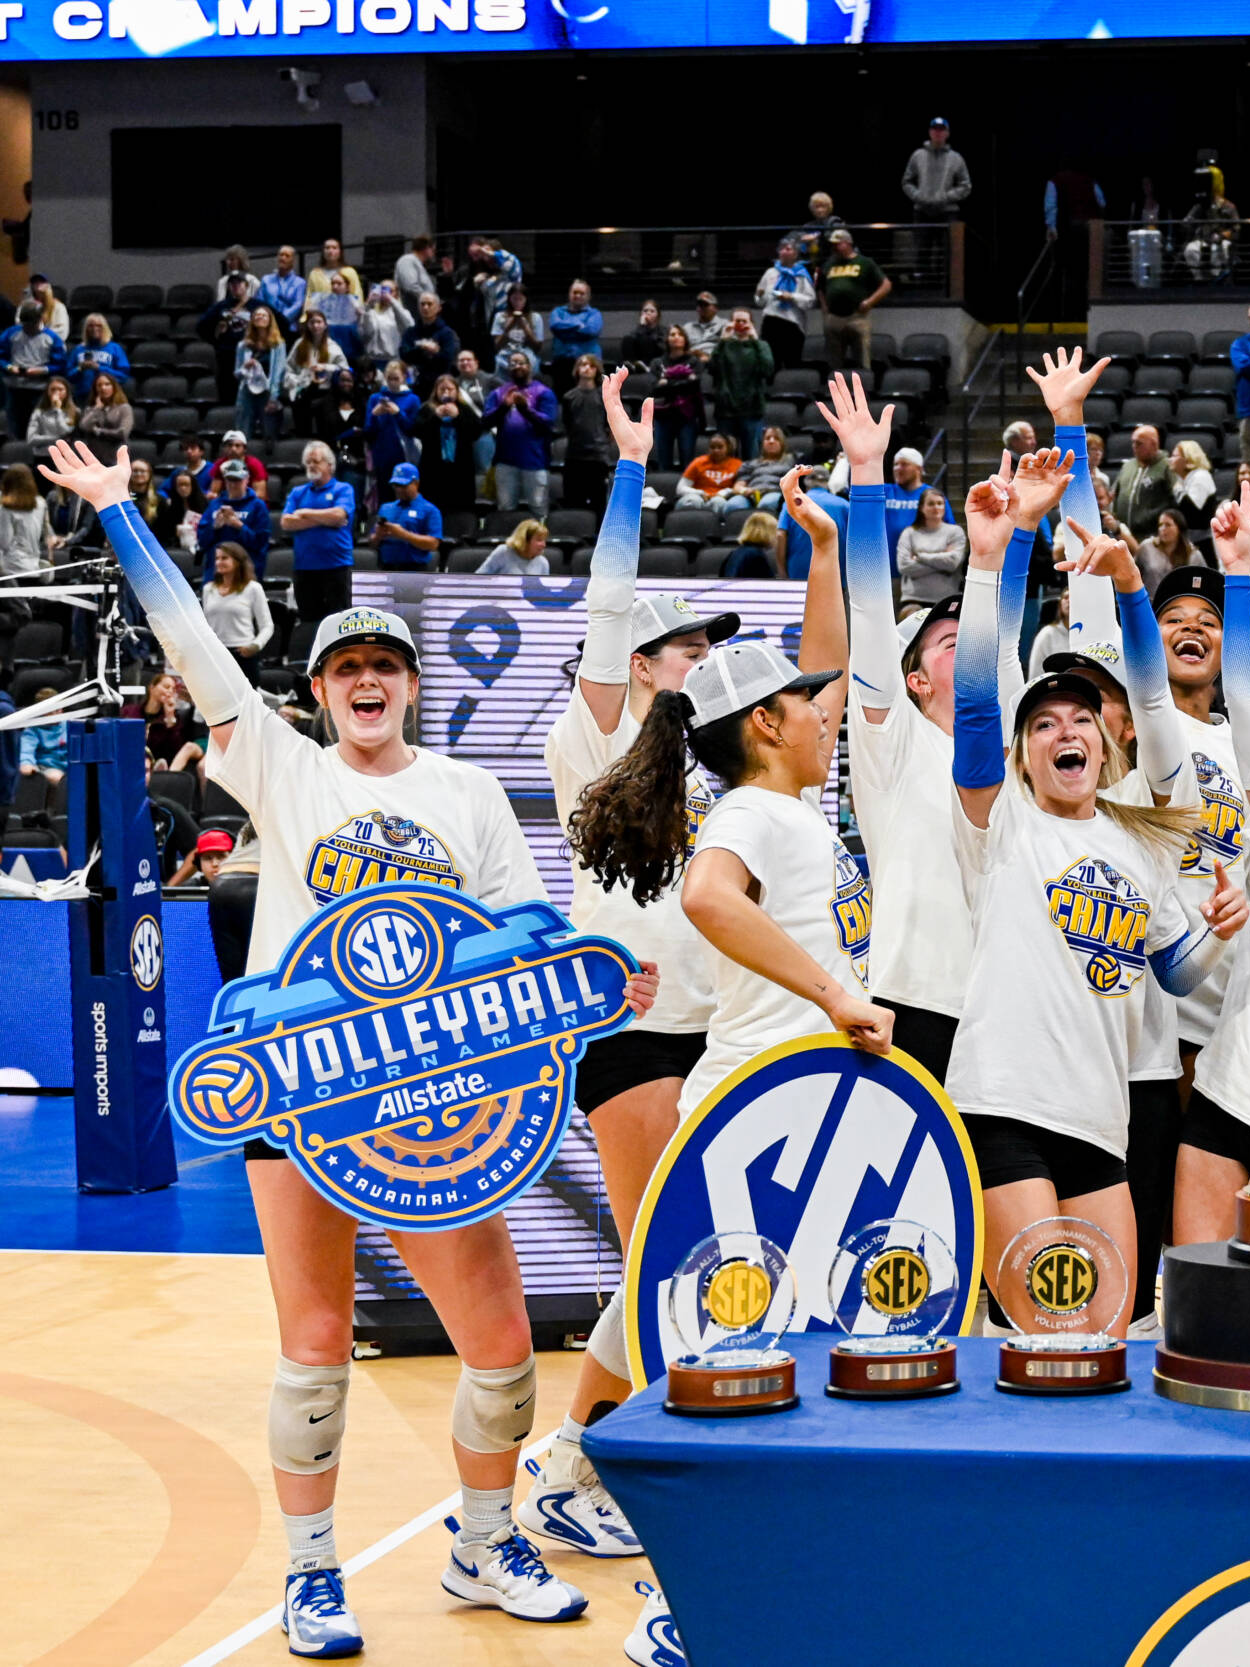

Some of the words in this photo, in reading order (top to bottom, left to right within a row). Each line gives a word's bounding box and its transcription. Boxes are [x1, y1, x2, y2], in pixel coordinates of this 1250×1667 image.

[35, 110, 79, 130] 106
[340, 620, 389, 634] CHAMPS
[1220, 777, 1233, 793] 25
[355, 820, 373, 840] 20
[418, 837, 434, 857] 25
[334, 839, 386, 861] VOLLEYBALL
[391, 854, 450, 873] TOURNAMENT
[1079, 865, 1096, 884] 20
[132, 879, 157, 897] Allstate
[1050, 888, 1147, 951] CHAMP
[133, 920, 161, 986] SEC
[352, 914, 423, 984] SEC
[91, 1002, 109, 1052] sports
[136, 1029, 161, 1044] Allstate
[264, 956, 606, 1092] VOLLEYBALL
[279, 1004, 608, 1109] TOURNAMENT
[93, 1057, 110, 1116] imports
[477, 1114, 544, 1191] GEORGIA
[714, 1268, 765, 1323] SEC
[874, 1257, 922, 1309] SEC
[1037, 1254, 1087, 1306] SEC
[1034, 1313, 1089, 1329] VOLLEYBALL
[302, 1560, 319, 1569] NIKE
